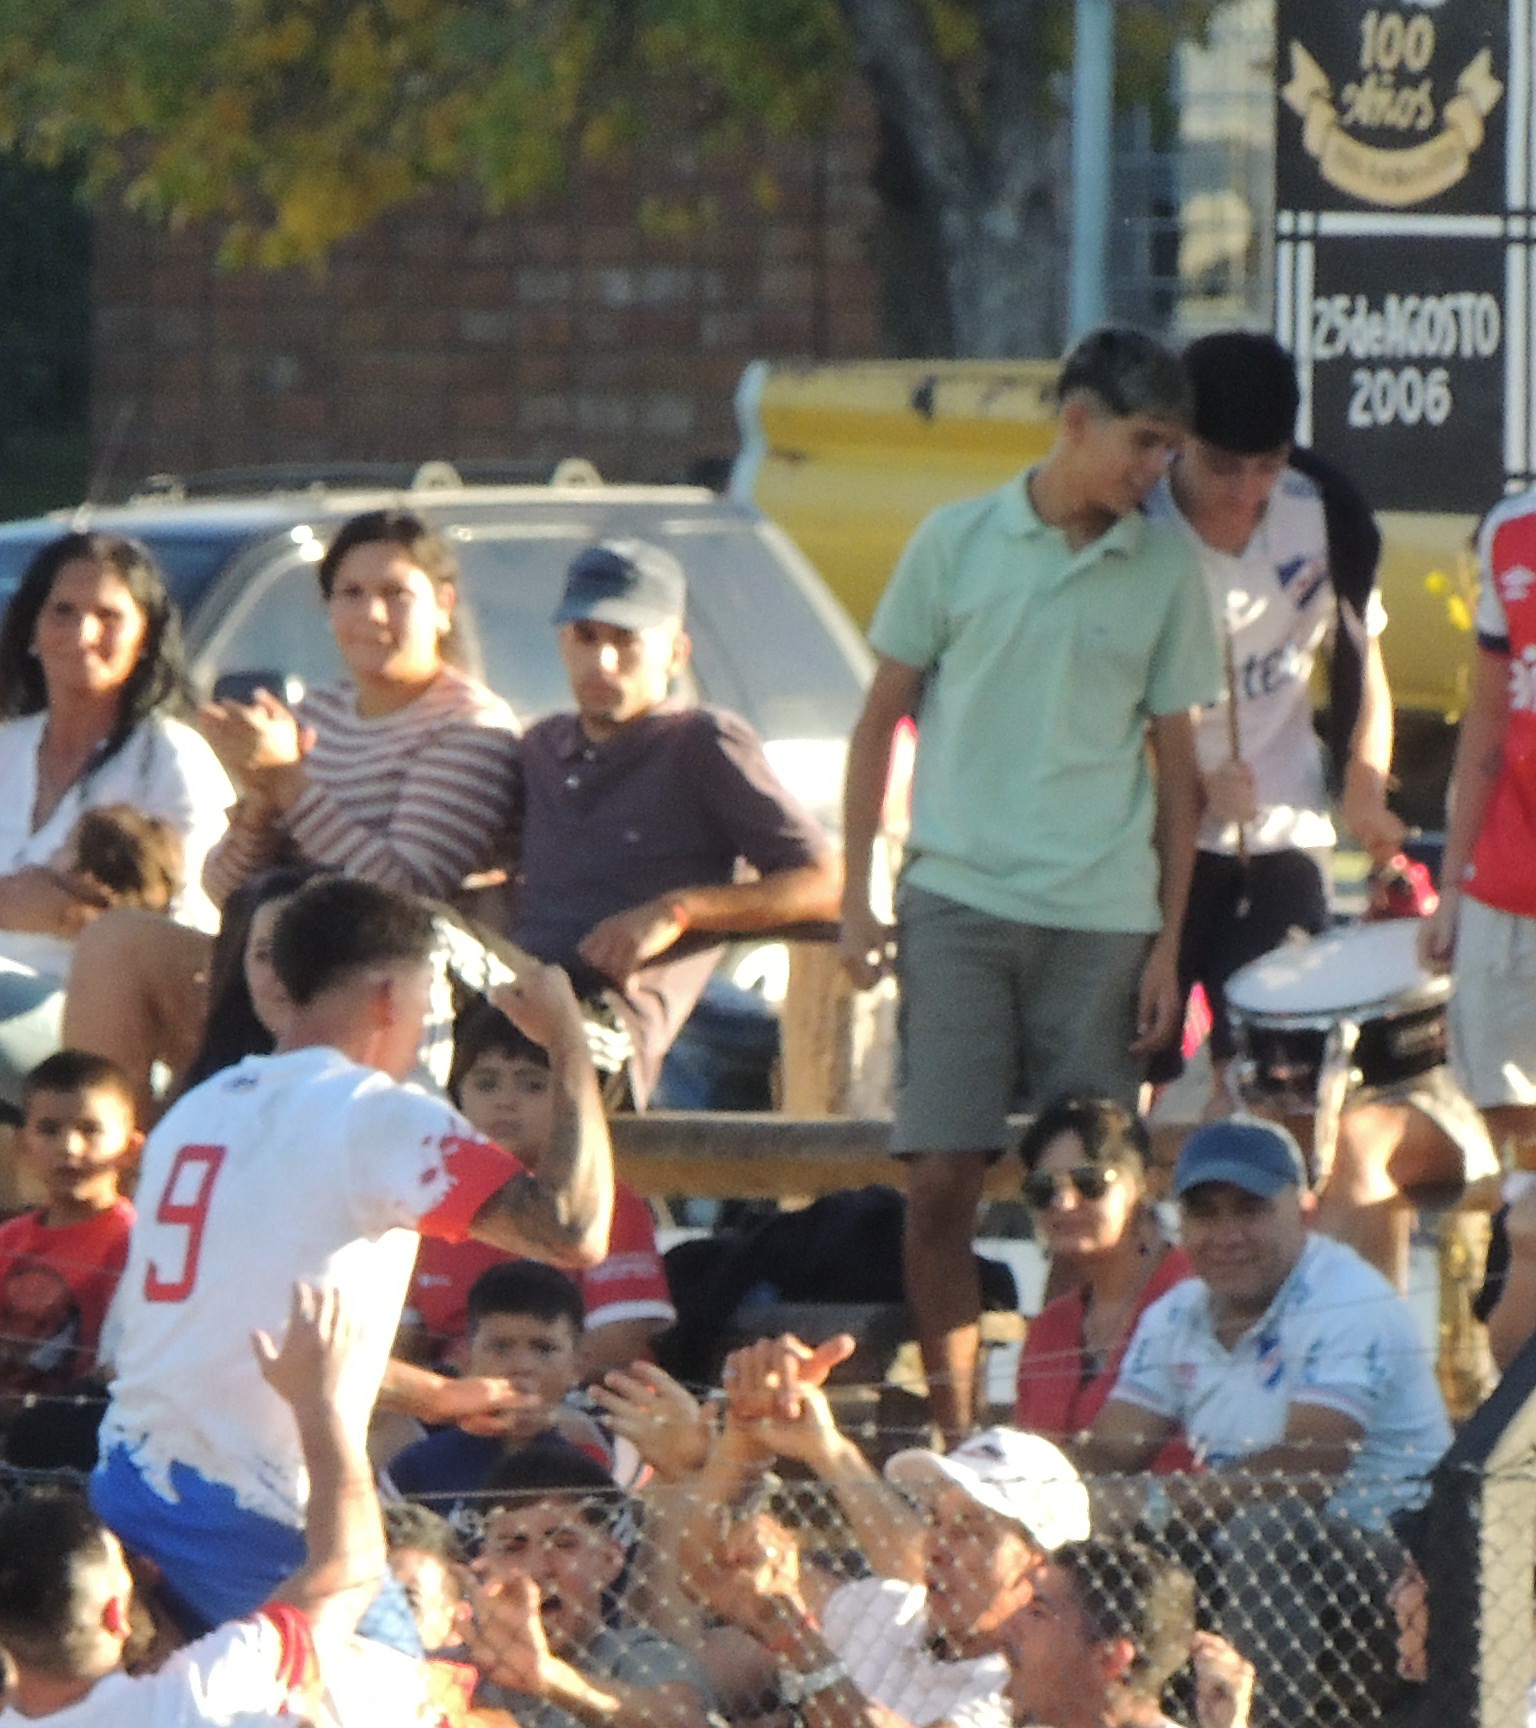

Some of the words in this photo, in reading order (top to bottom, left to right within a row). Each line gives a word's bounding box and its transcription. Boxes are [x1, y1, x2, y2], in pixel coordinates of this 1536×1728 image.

[1360, 9, 1436, 73] 100
[1347, 365, 1454, 429] 2006
[143, 1143, 227, 1304] 9
